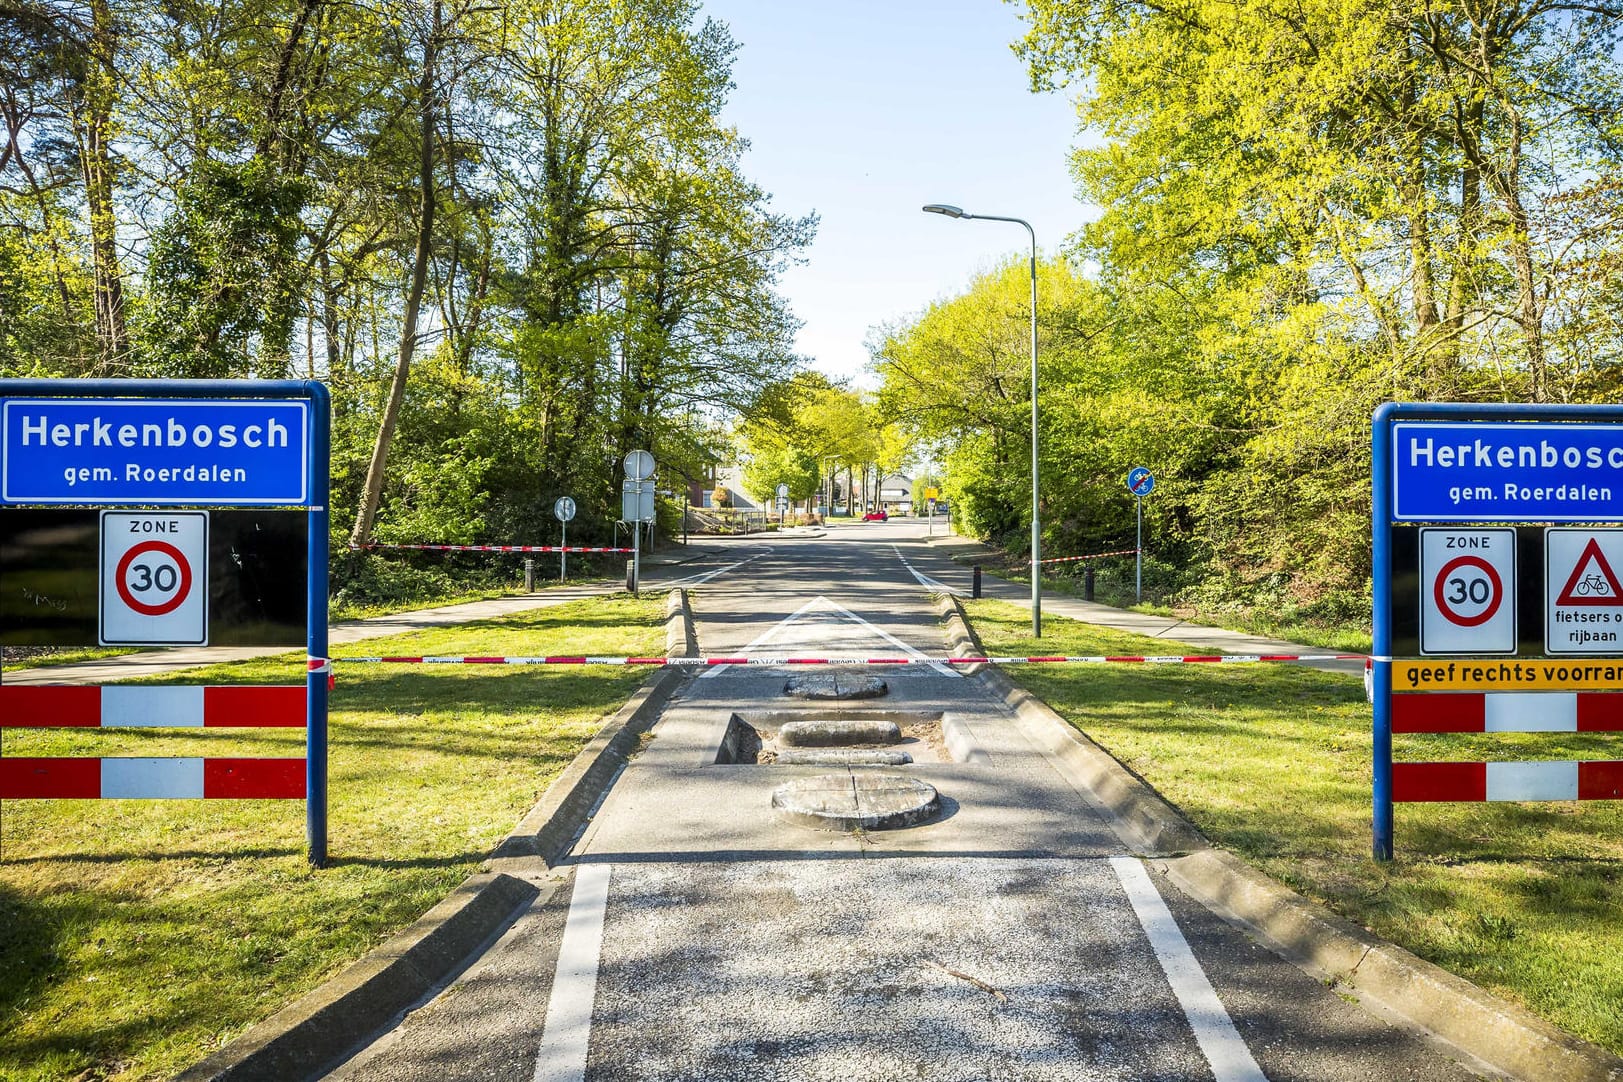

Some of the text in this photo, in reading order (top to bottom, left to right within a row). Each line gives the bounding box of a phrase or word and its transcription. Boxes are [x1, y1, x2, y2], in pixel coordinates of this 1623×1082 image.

[22, 415, 288, 448] Herkenbosch
[1410, 438, 1623, 469] Herkenbosc
[64, 463, 246, 486] gem. Roerdalen
[1449, 484, 1611, 505] gem. Roerdalen
[130, 521, 179, 533] ZONE
[1446, 537, 1490, 549] ZONE
[131, 564, 177, 592] 30
[1448, 578, 1490, 605] 30
[1556, 611, 1610, 623] fietsers
[1569, 630, 1617, 645] rijbaan
[1407, 663, 1456, 687] geef
[1463, 663, 1537, 682] rechts
